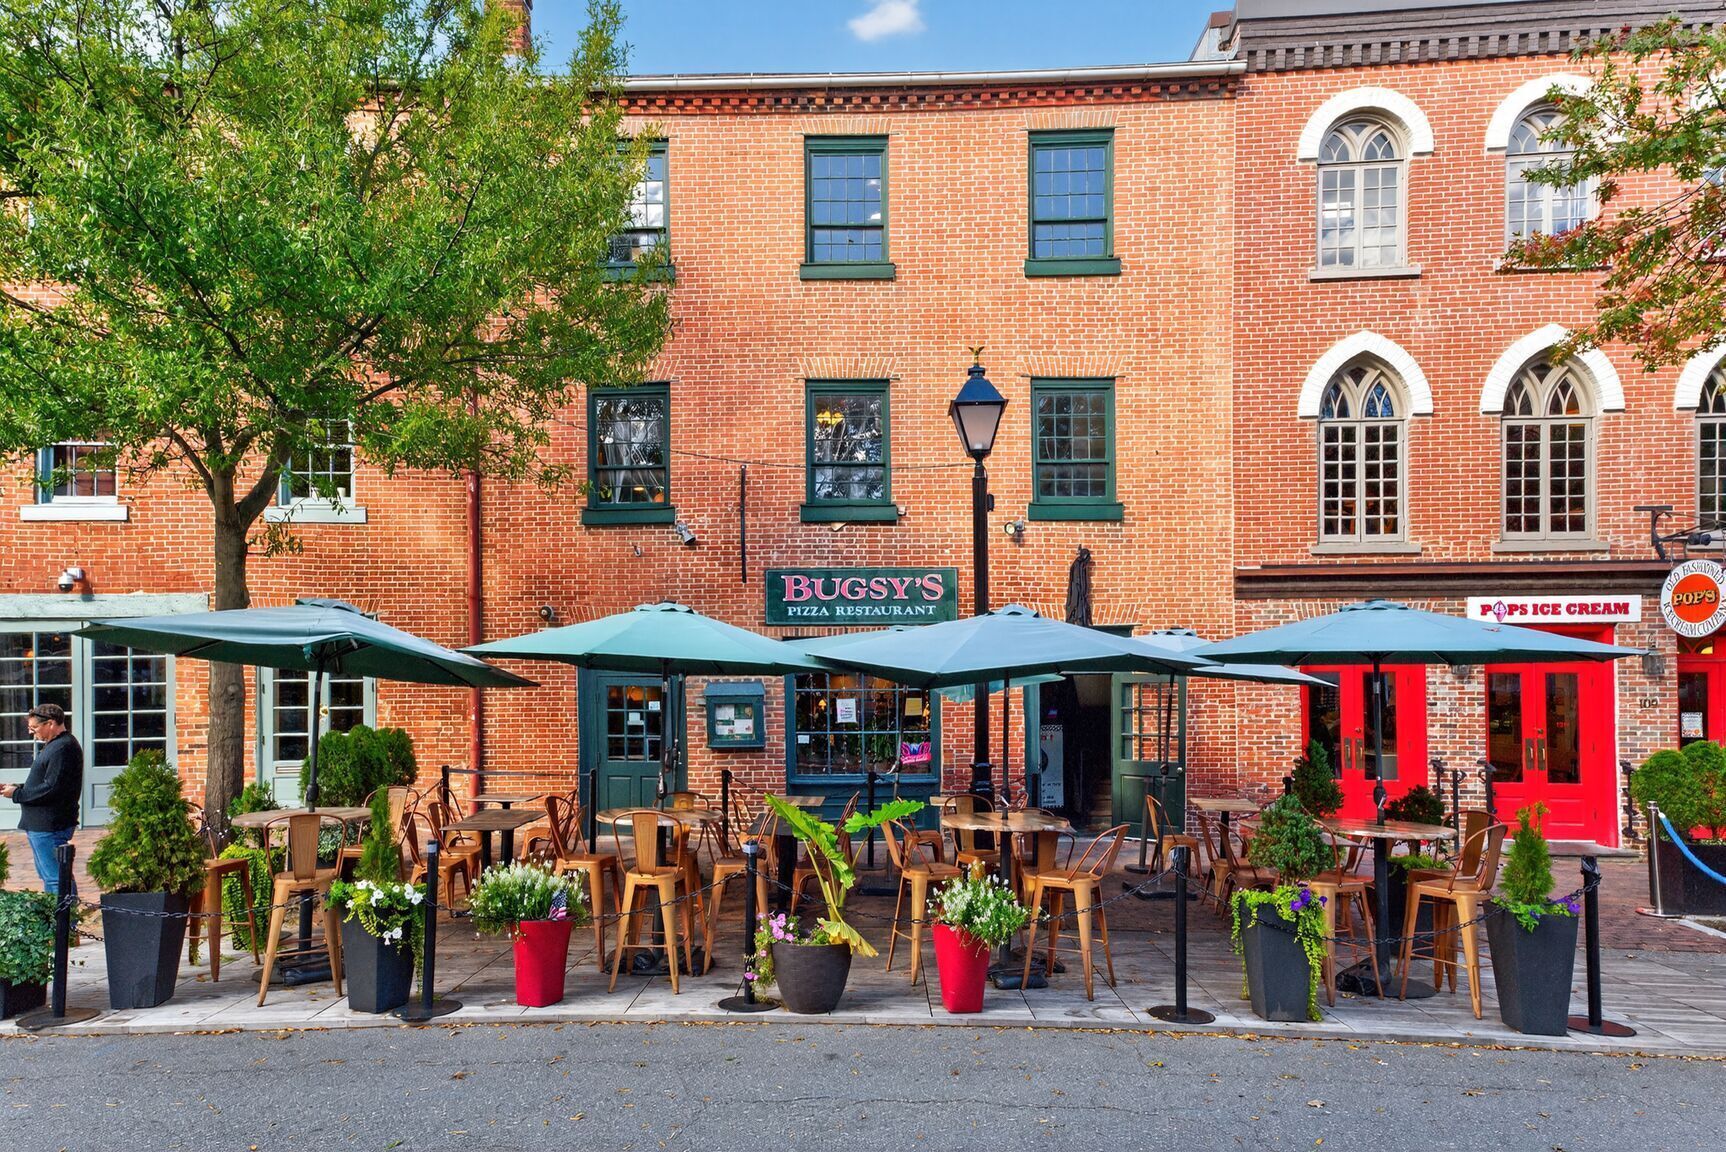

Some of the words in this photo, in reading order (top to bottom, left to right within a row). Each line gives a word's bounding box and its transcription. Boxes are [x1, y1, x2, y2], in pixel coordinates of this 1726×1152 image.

[1665, 572, 1680, 592] OLD
[1682, 561, 1725, 585] FASHIONED
[781, 574, 944, 601] BUGSY'S
[1673, 589, 1716, 606] POP'S
[787, 606, 829, 616] PIZZA
[835, 605, 937, 616] RESTAURANT
[1532, 603, 1561, 616] ICE
[1565, 602, 1630, 615] CREAM
[1639, 698, 1658, 709] 109
